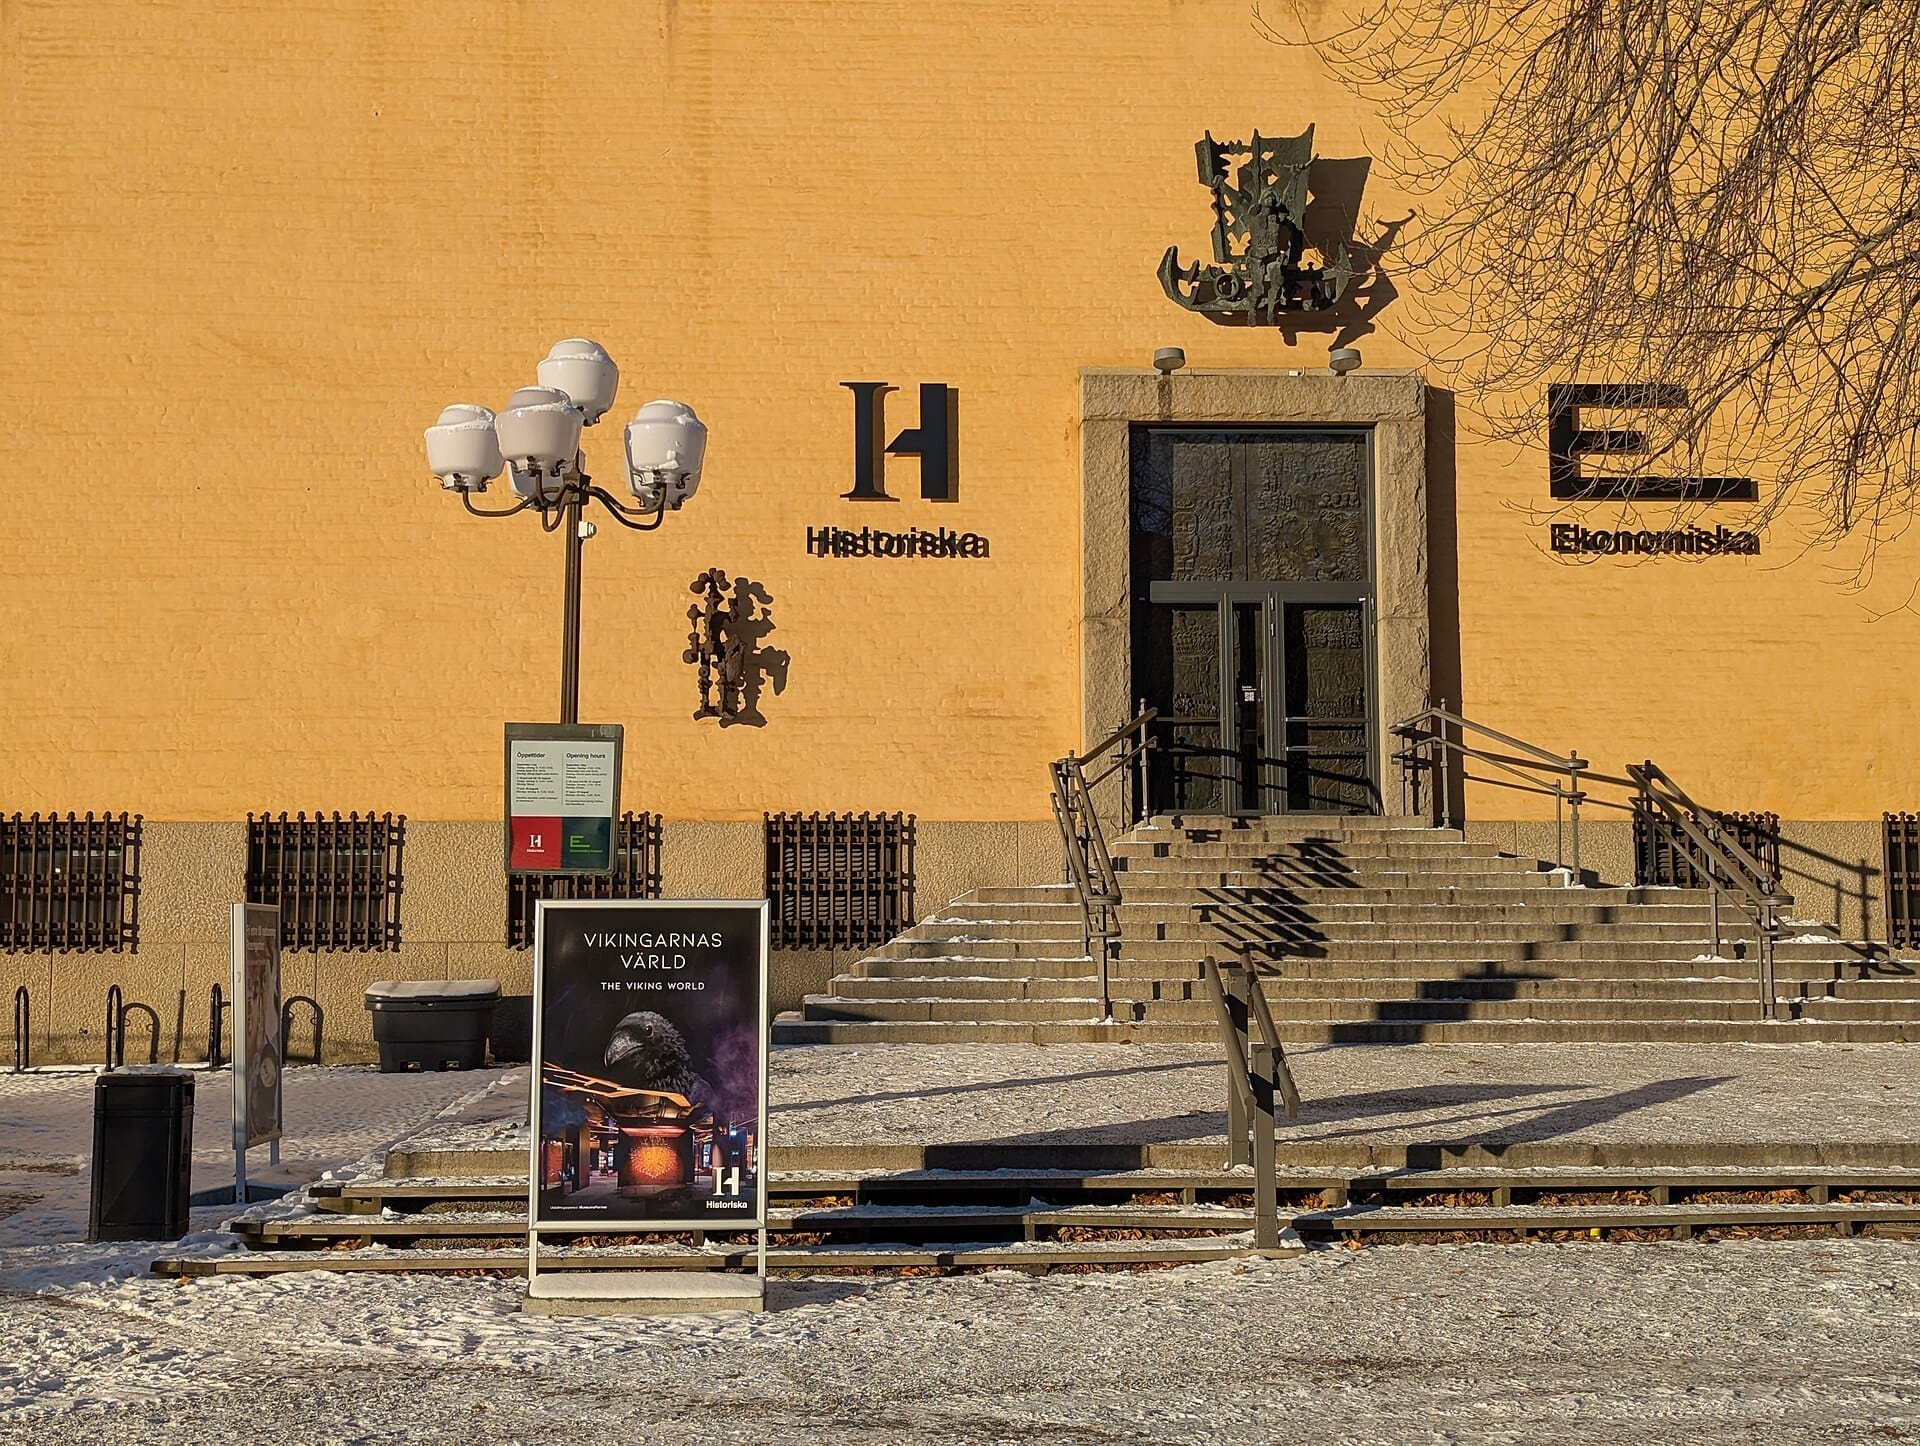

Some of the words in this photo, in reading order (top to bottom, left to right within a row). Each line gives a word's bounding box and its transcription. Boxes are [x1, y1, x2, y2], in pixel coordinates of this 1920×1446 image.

[839, 382, 948, 499] H
[1549, 384, 1752, 498] E
[807, 526, 981, 555] Historiska
[1551, 524, 1759, 554] Ekonomiska
[530, 834, 542, 848] H
[584, 933, 722, 948] VIKINGARNAS
[620, 952, 686, 969] VÄRLD
[601, 982, 621, 991] THE
[626, 982, 663, 991] VIKING
[667, 982, 705, 991] WORLD
[712, 1166, 740, 1196] H
[706, 1200, 748, 1209] Historiska
